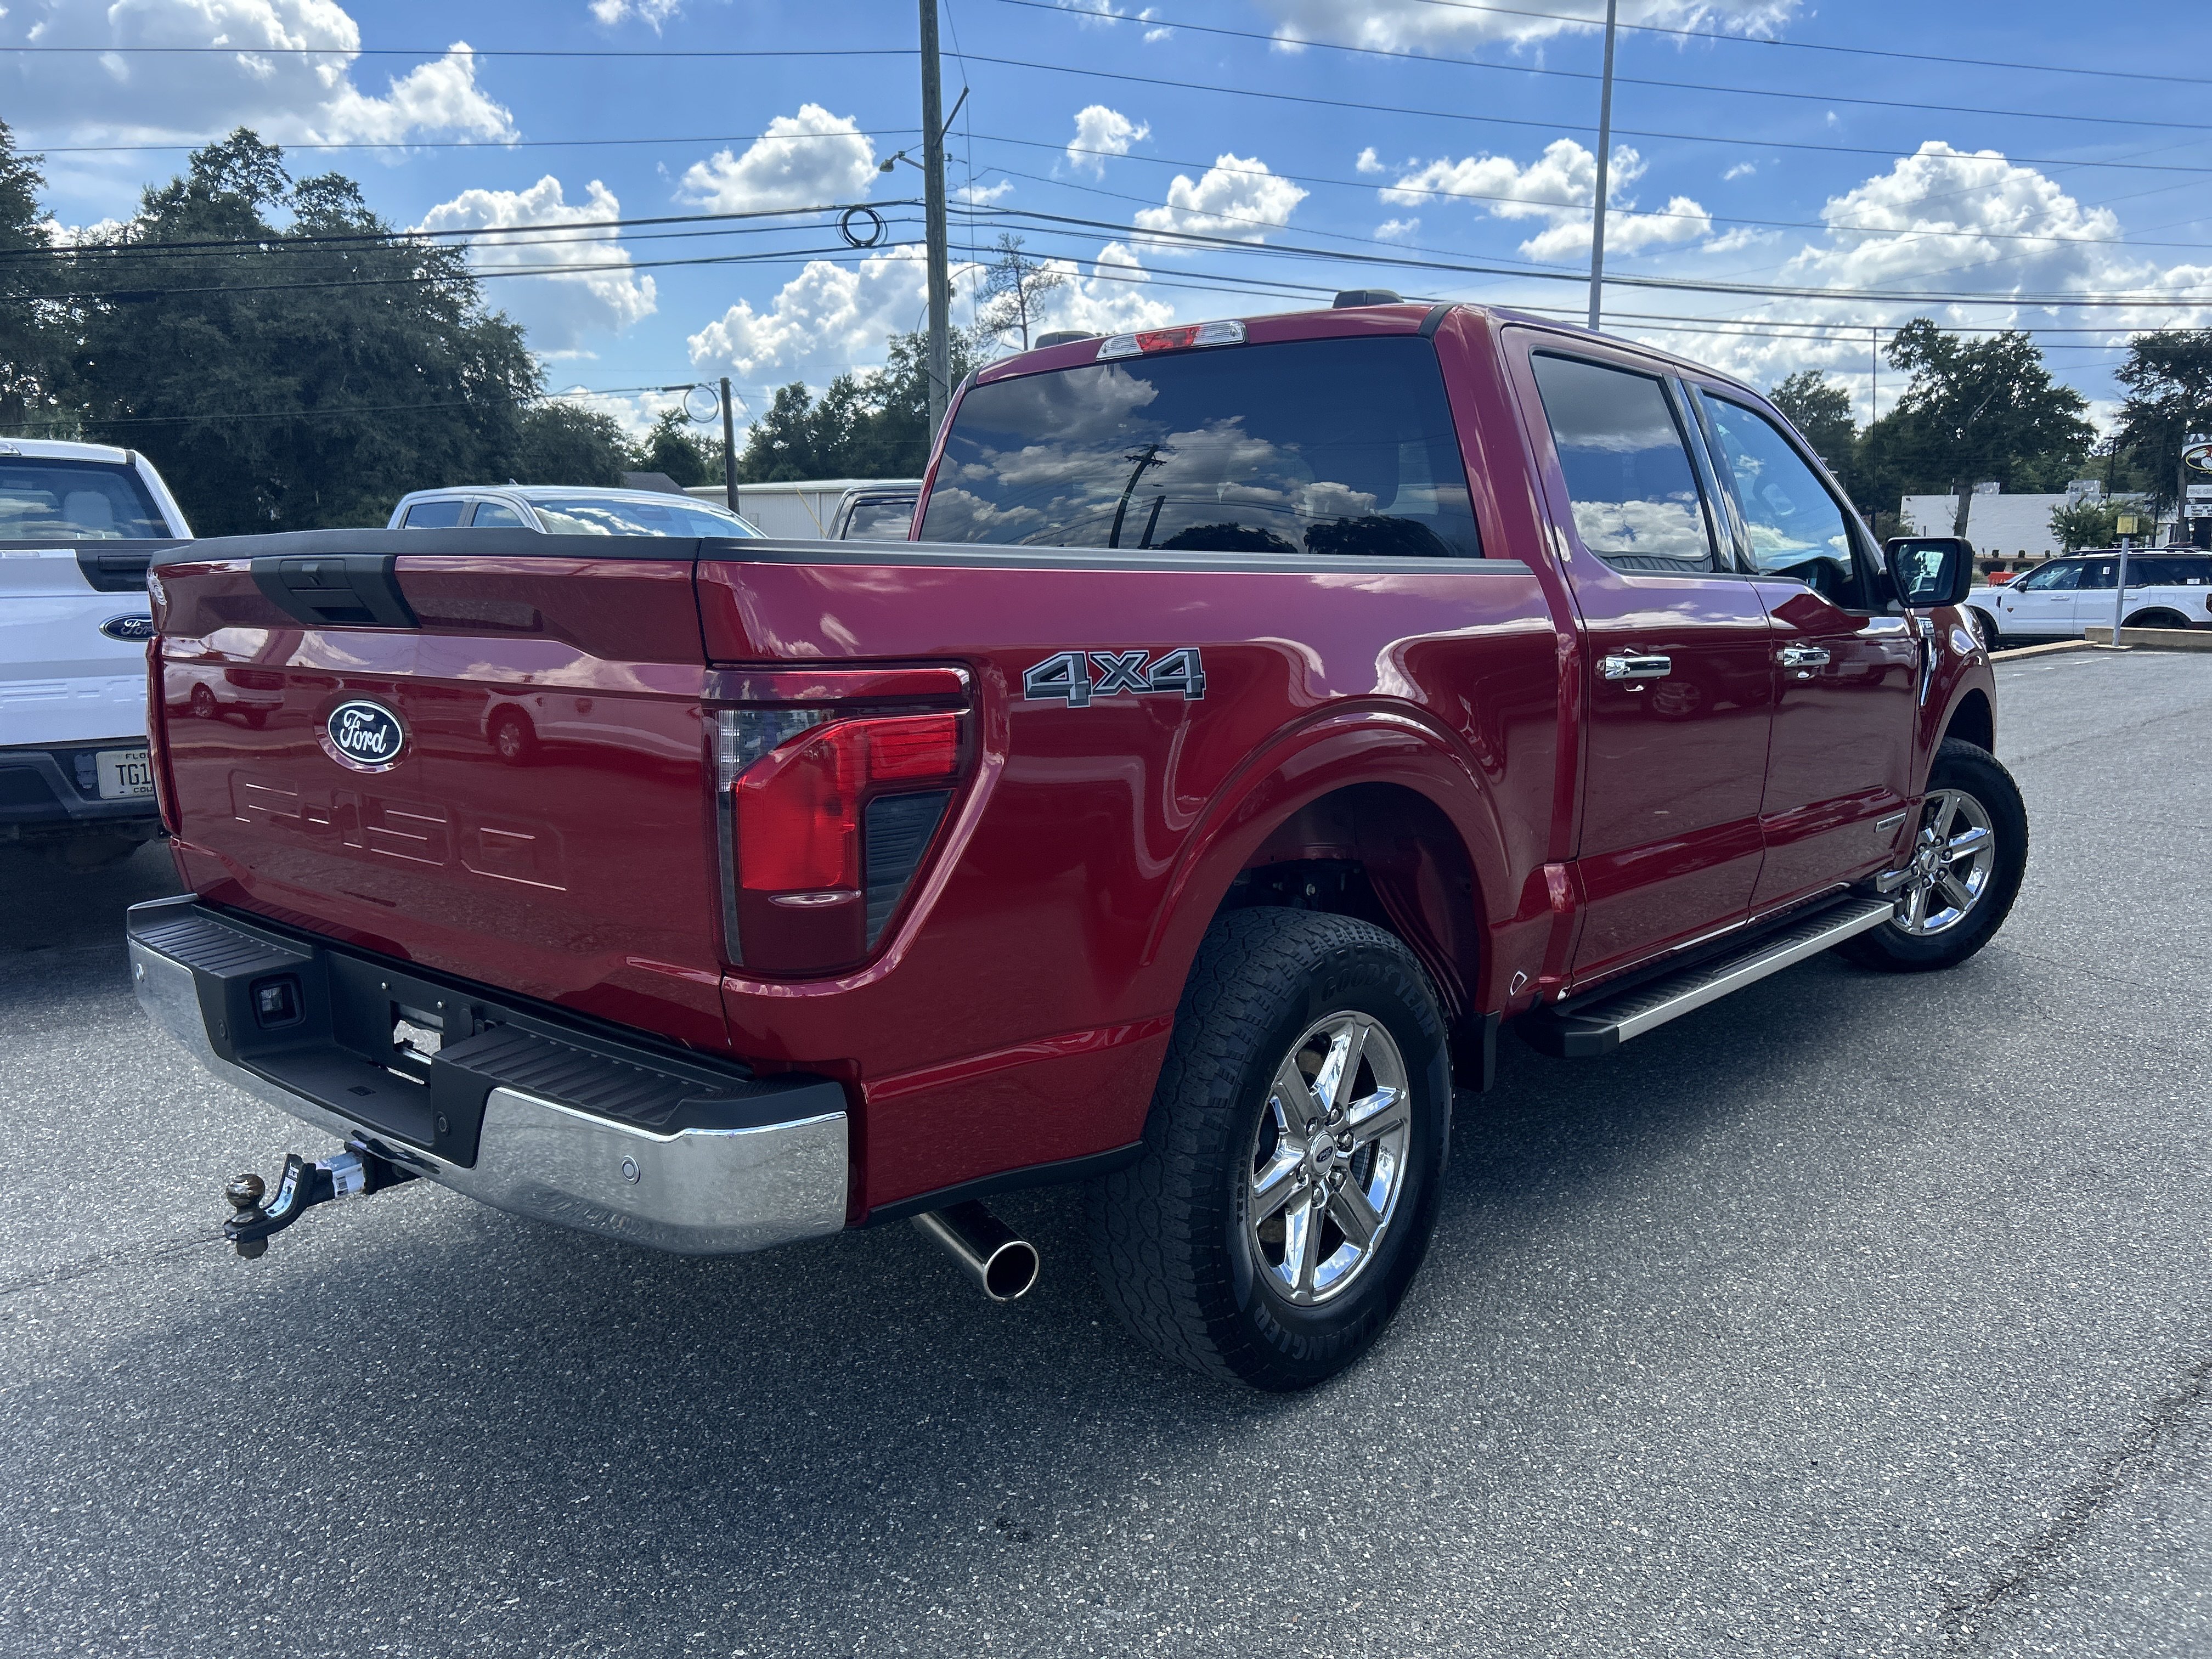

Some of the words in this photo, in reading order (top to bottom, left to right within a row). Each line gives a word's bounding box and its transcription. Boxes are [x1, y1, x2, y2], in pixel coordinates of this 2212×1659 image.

[120, 618, 153, 636] For
[340, 709, 387, 754] Ford
[115, 763, 151, 786] TG1
